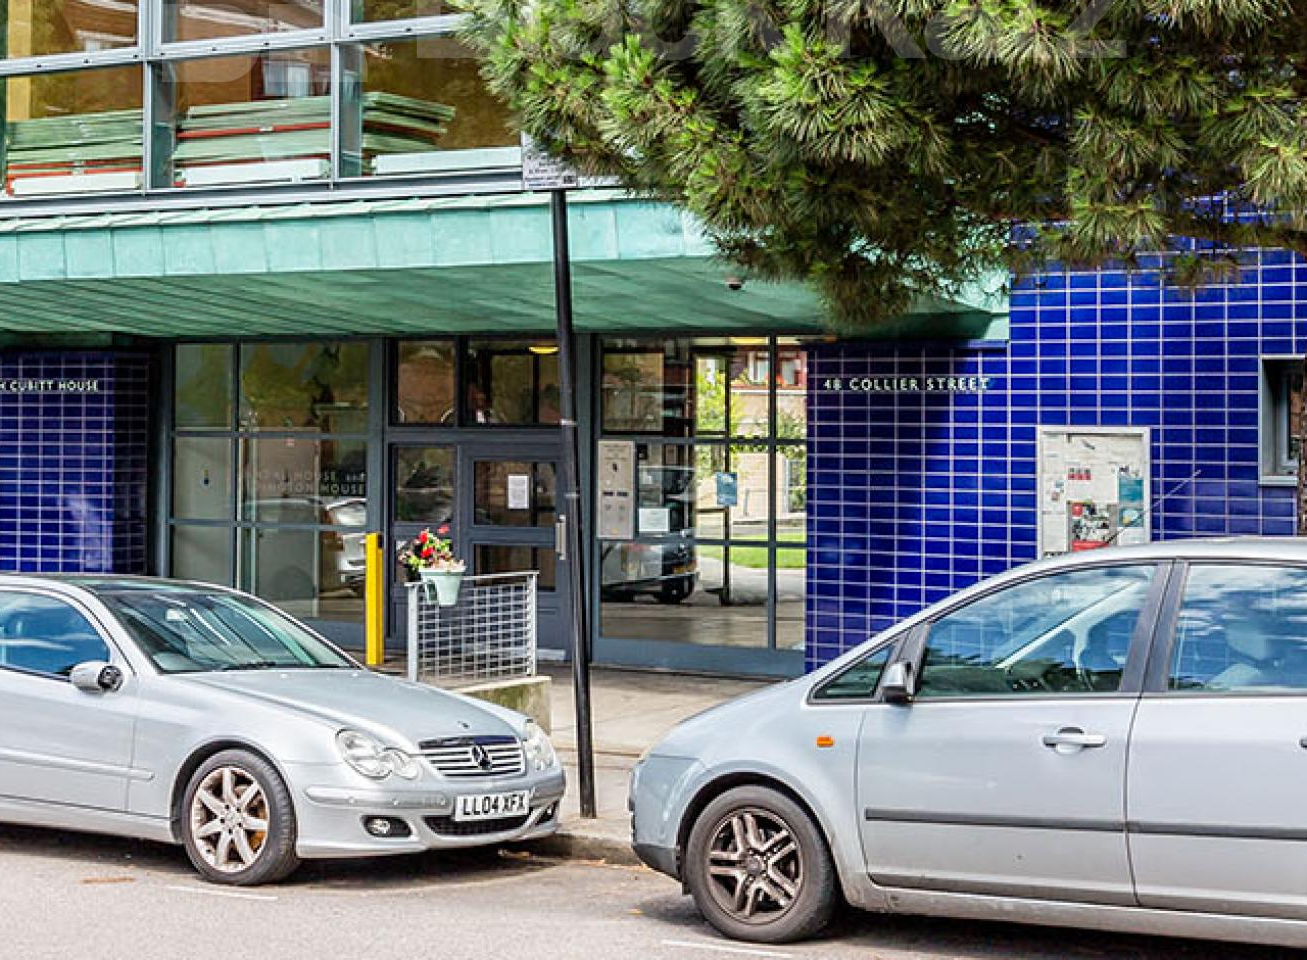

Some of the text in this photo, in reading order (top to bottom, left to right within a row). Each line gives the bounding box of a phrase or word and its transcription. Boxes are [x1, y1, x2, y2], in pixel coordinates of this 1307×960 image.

[10, 379, 54, 392] CUBITT
[59, 379, 99, 392] HOUSE
[823, 377, 990, 391] 48 COLLIER STREET
[463, 793, 526, 815] LL04 XFX
